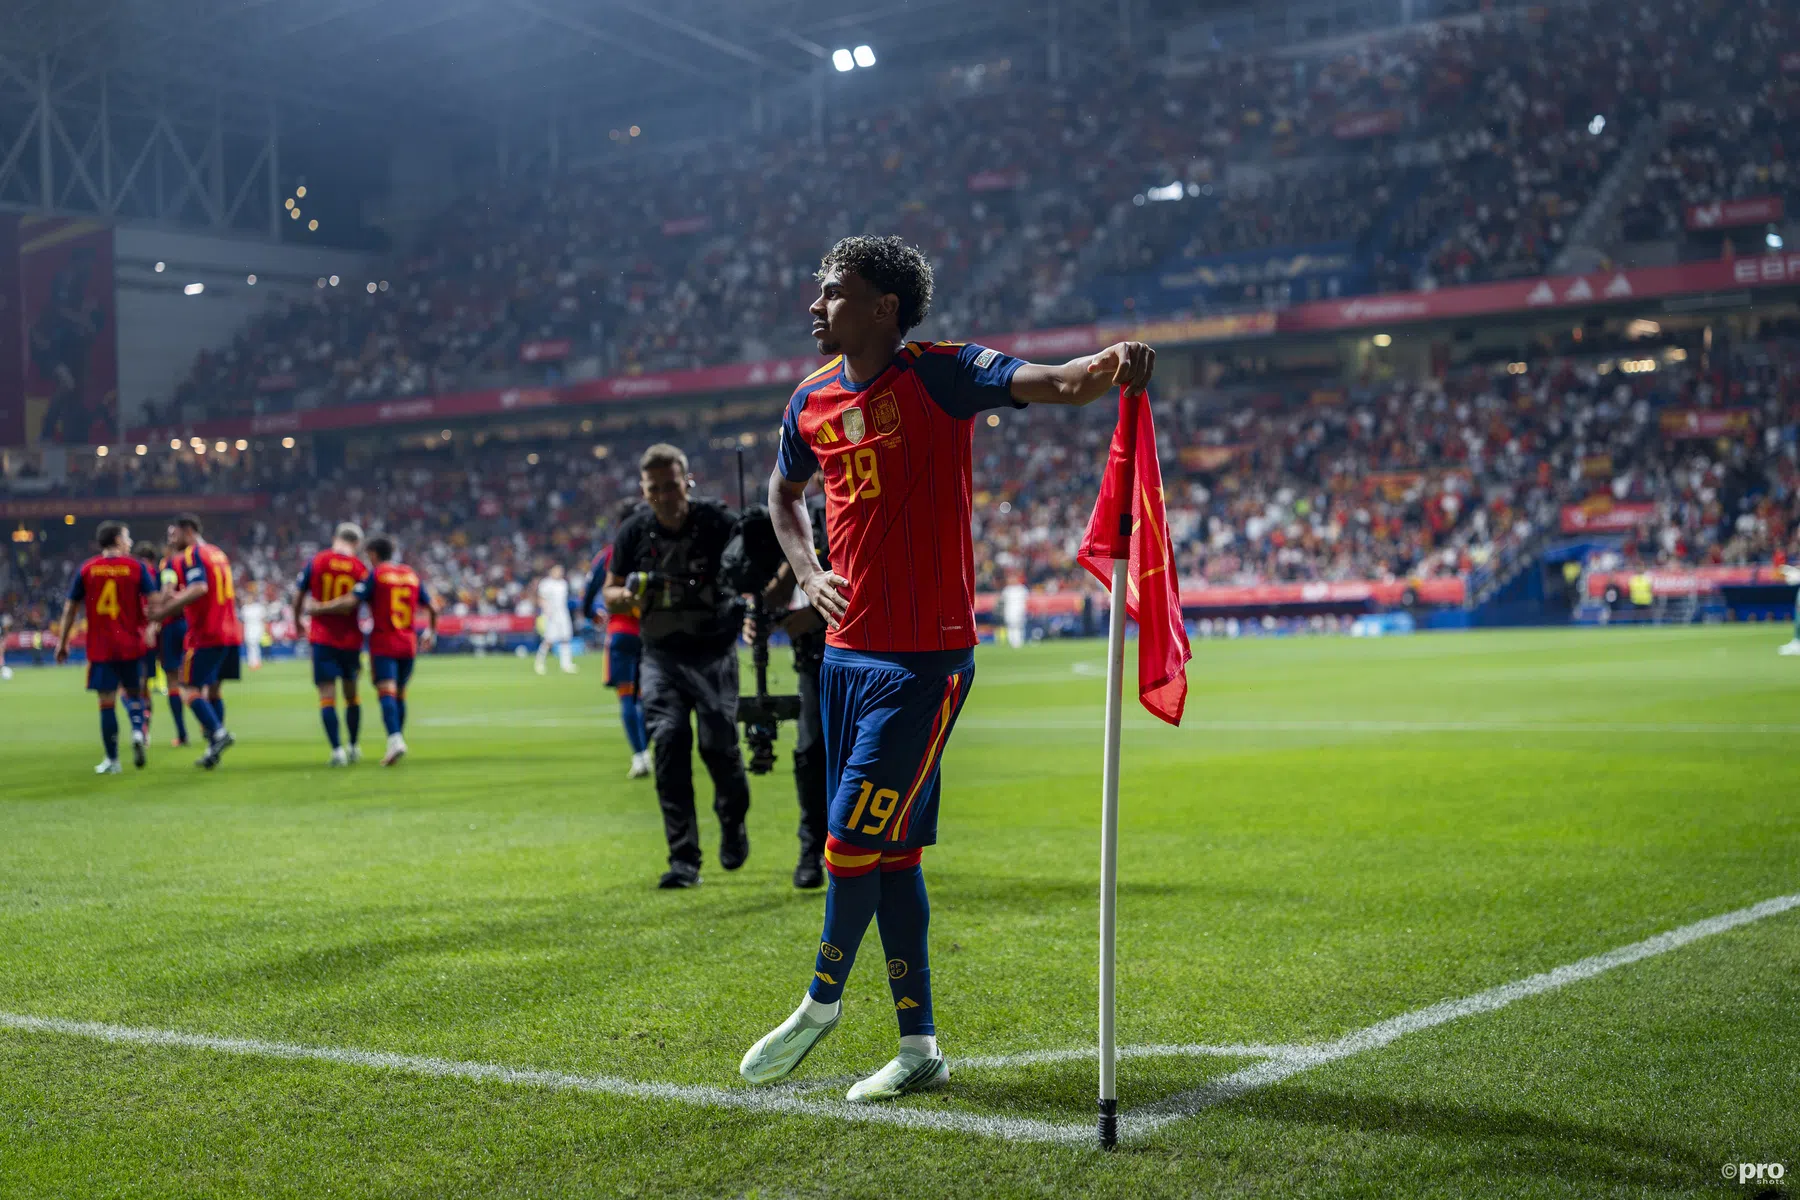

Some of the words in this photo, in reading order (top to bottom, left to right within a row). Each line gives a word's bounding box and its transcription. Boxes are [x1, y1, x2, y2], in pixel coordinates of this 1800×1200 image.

[841, 447, 881, 504] 19
[96, 578, 120, 620] 4
[390, 586, 411, 630] 5
[846, 780, 899, 835] 19
